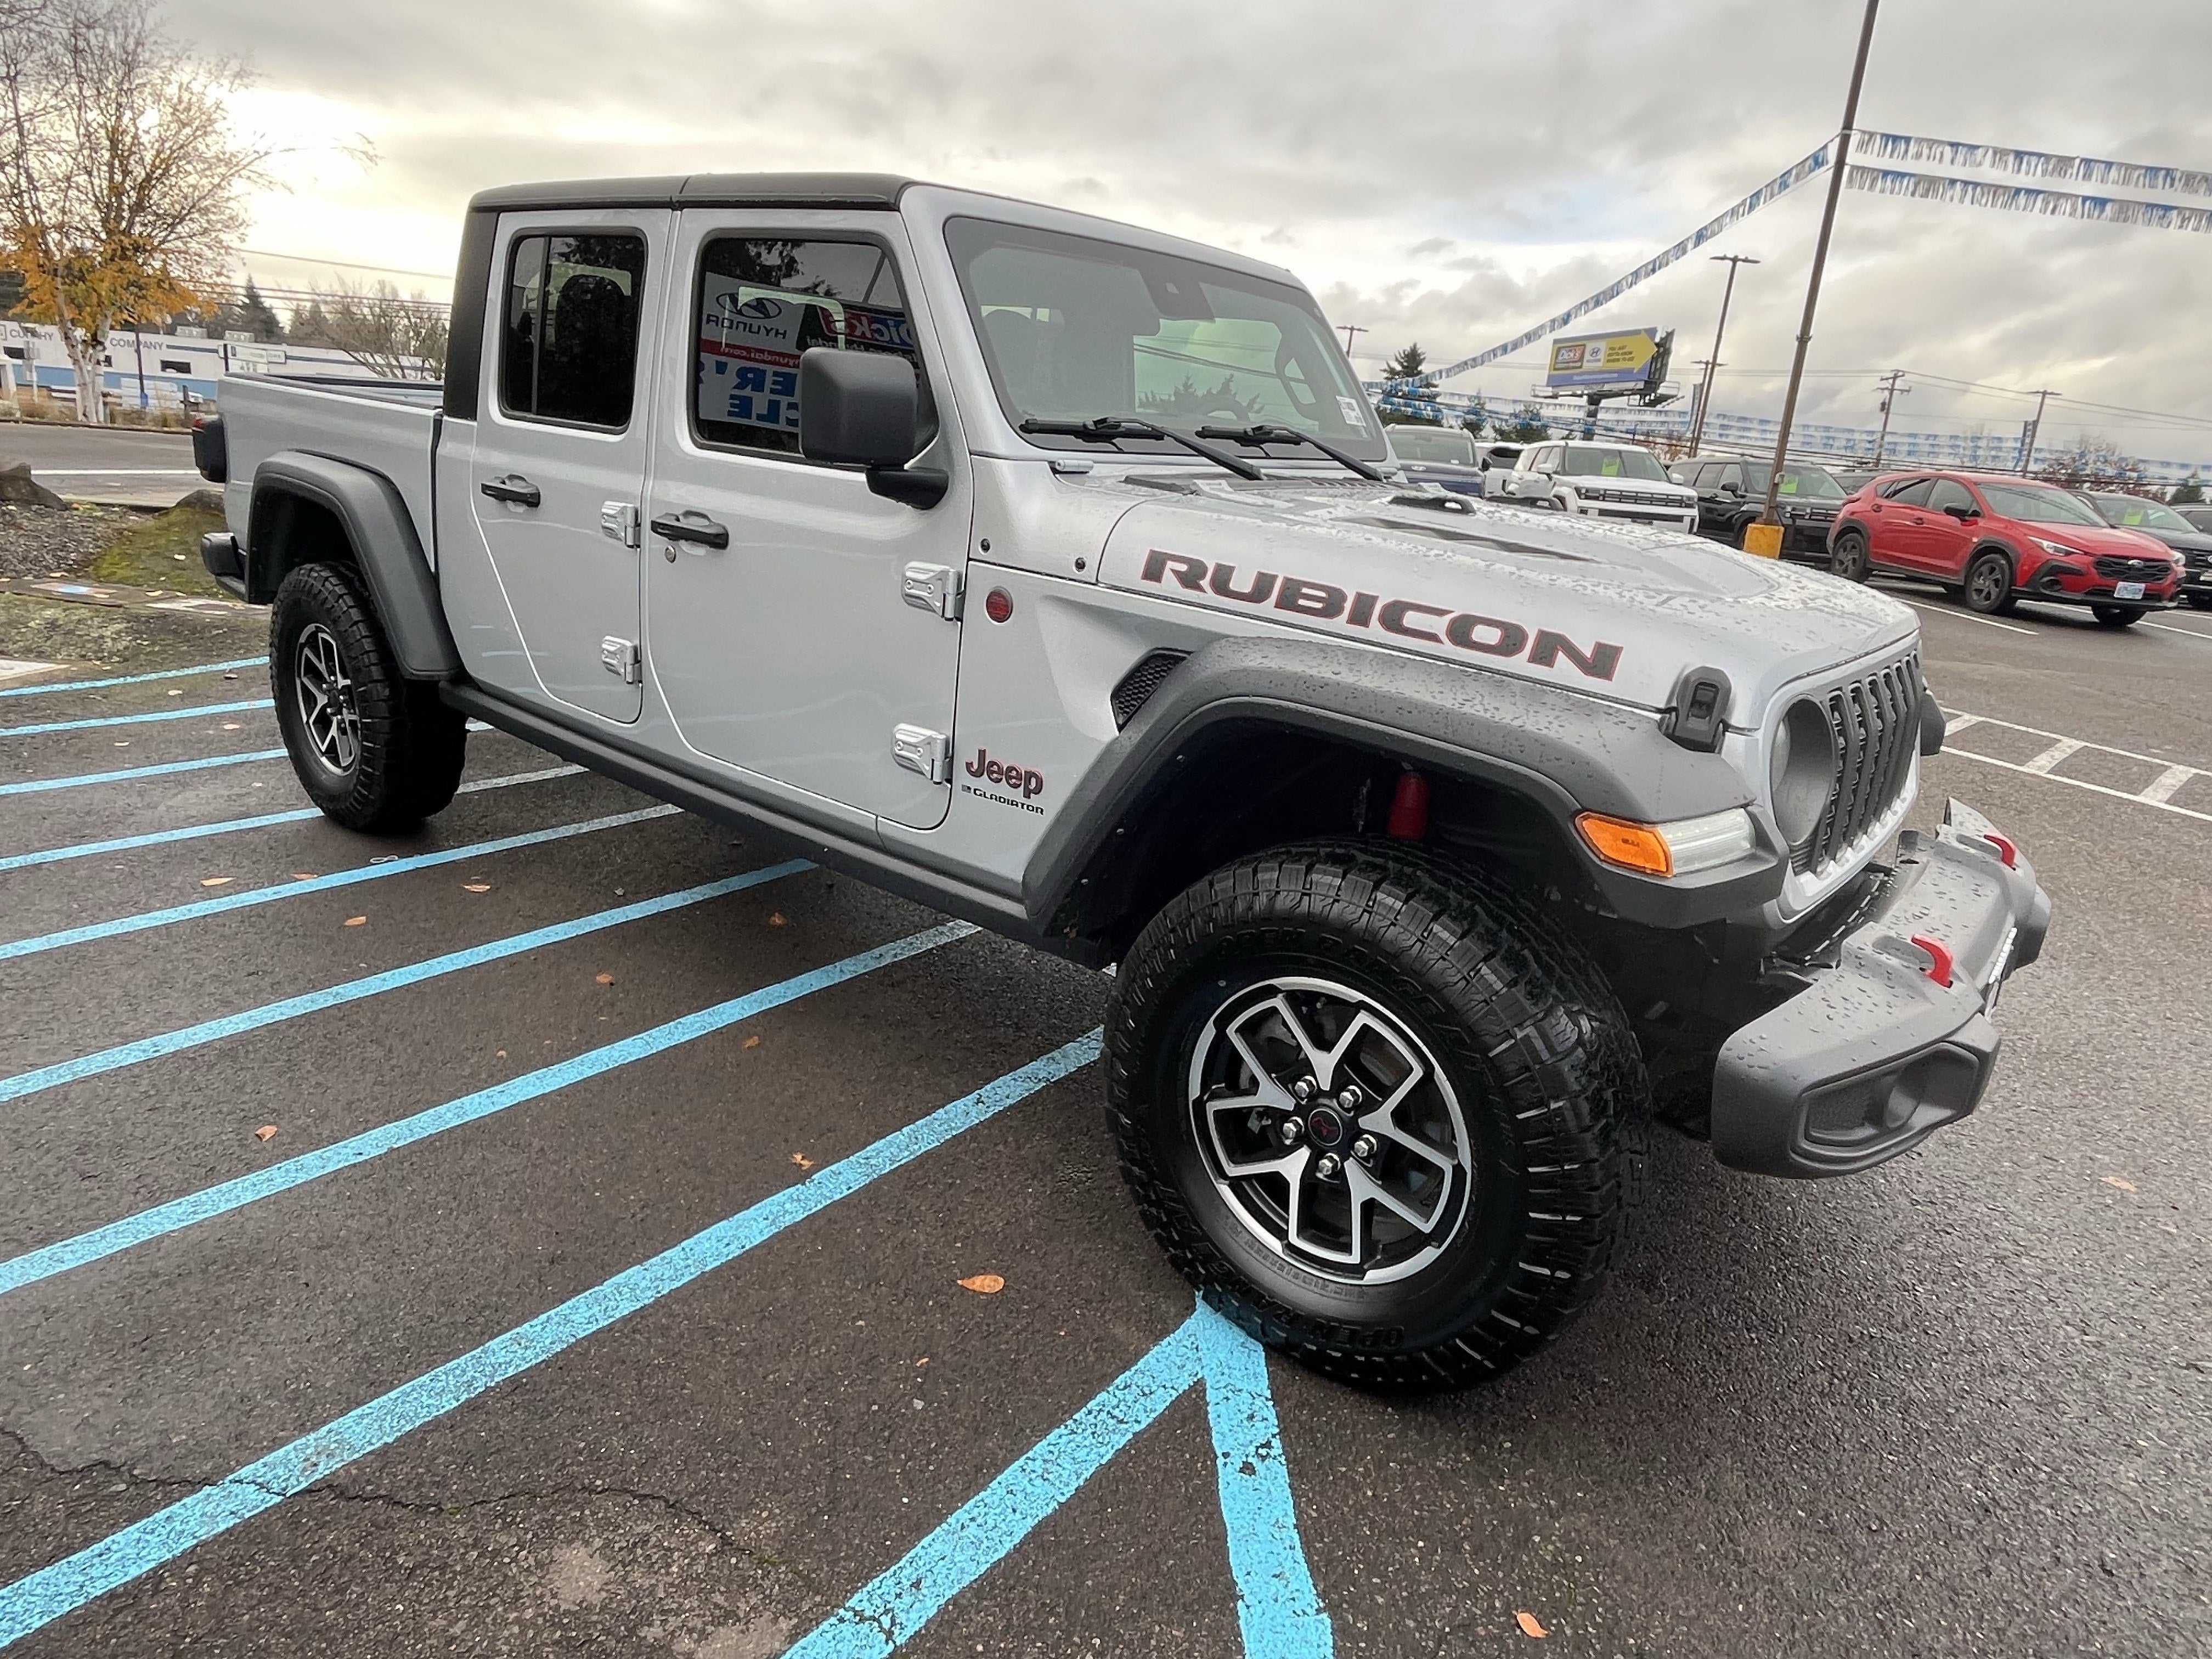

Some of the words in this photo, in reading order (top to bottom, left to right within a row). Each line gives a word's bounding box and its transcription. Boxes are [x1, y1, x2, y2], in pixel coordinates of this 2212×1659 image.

[1140, 548, 1624, 682] RUBICON
[965, 747, 1044, 800] Jeep
[973, 787, 1045, 815] GLADIATOR
